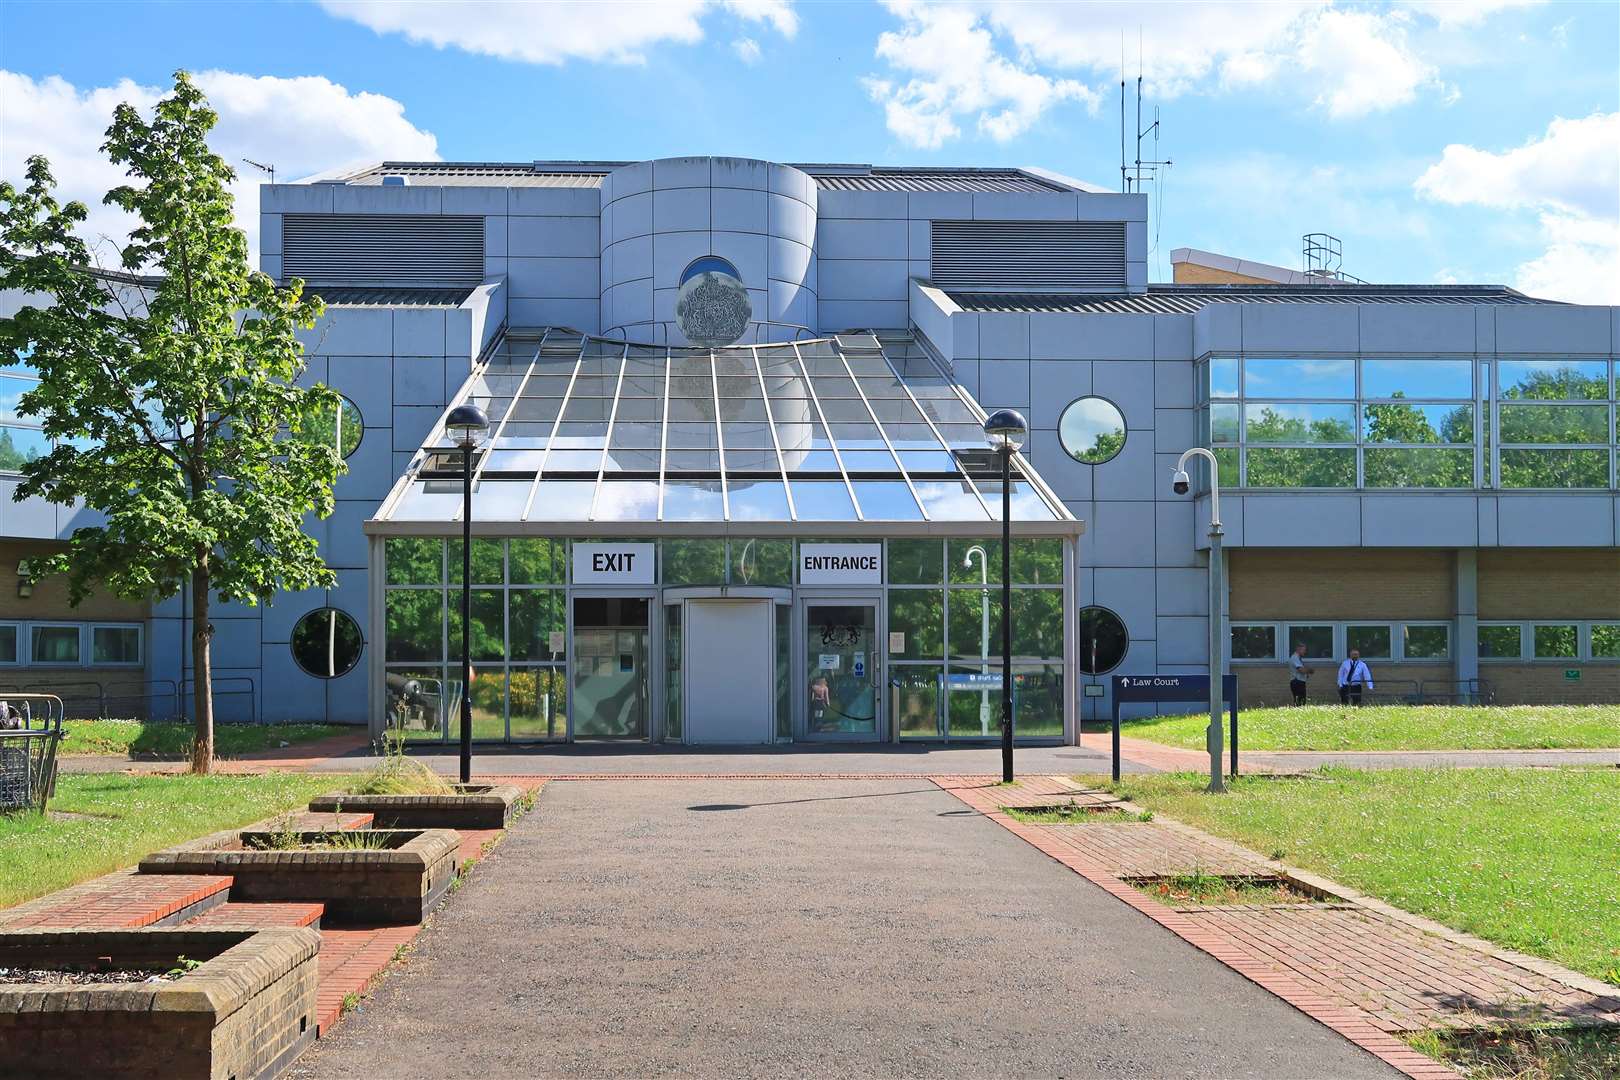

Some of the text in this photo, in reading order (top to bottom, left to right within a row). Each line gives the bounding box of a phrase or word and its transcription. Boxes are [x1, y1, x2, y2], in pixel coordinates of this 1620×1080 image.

[592, 553, 636, 572] EXIT
[804, 556, 878, 570] ENTRANCE
[1132, 677, 1180, 686] Law Court
